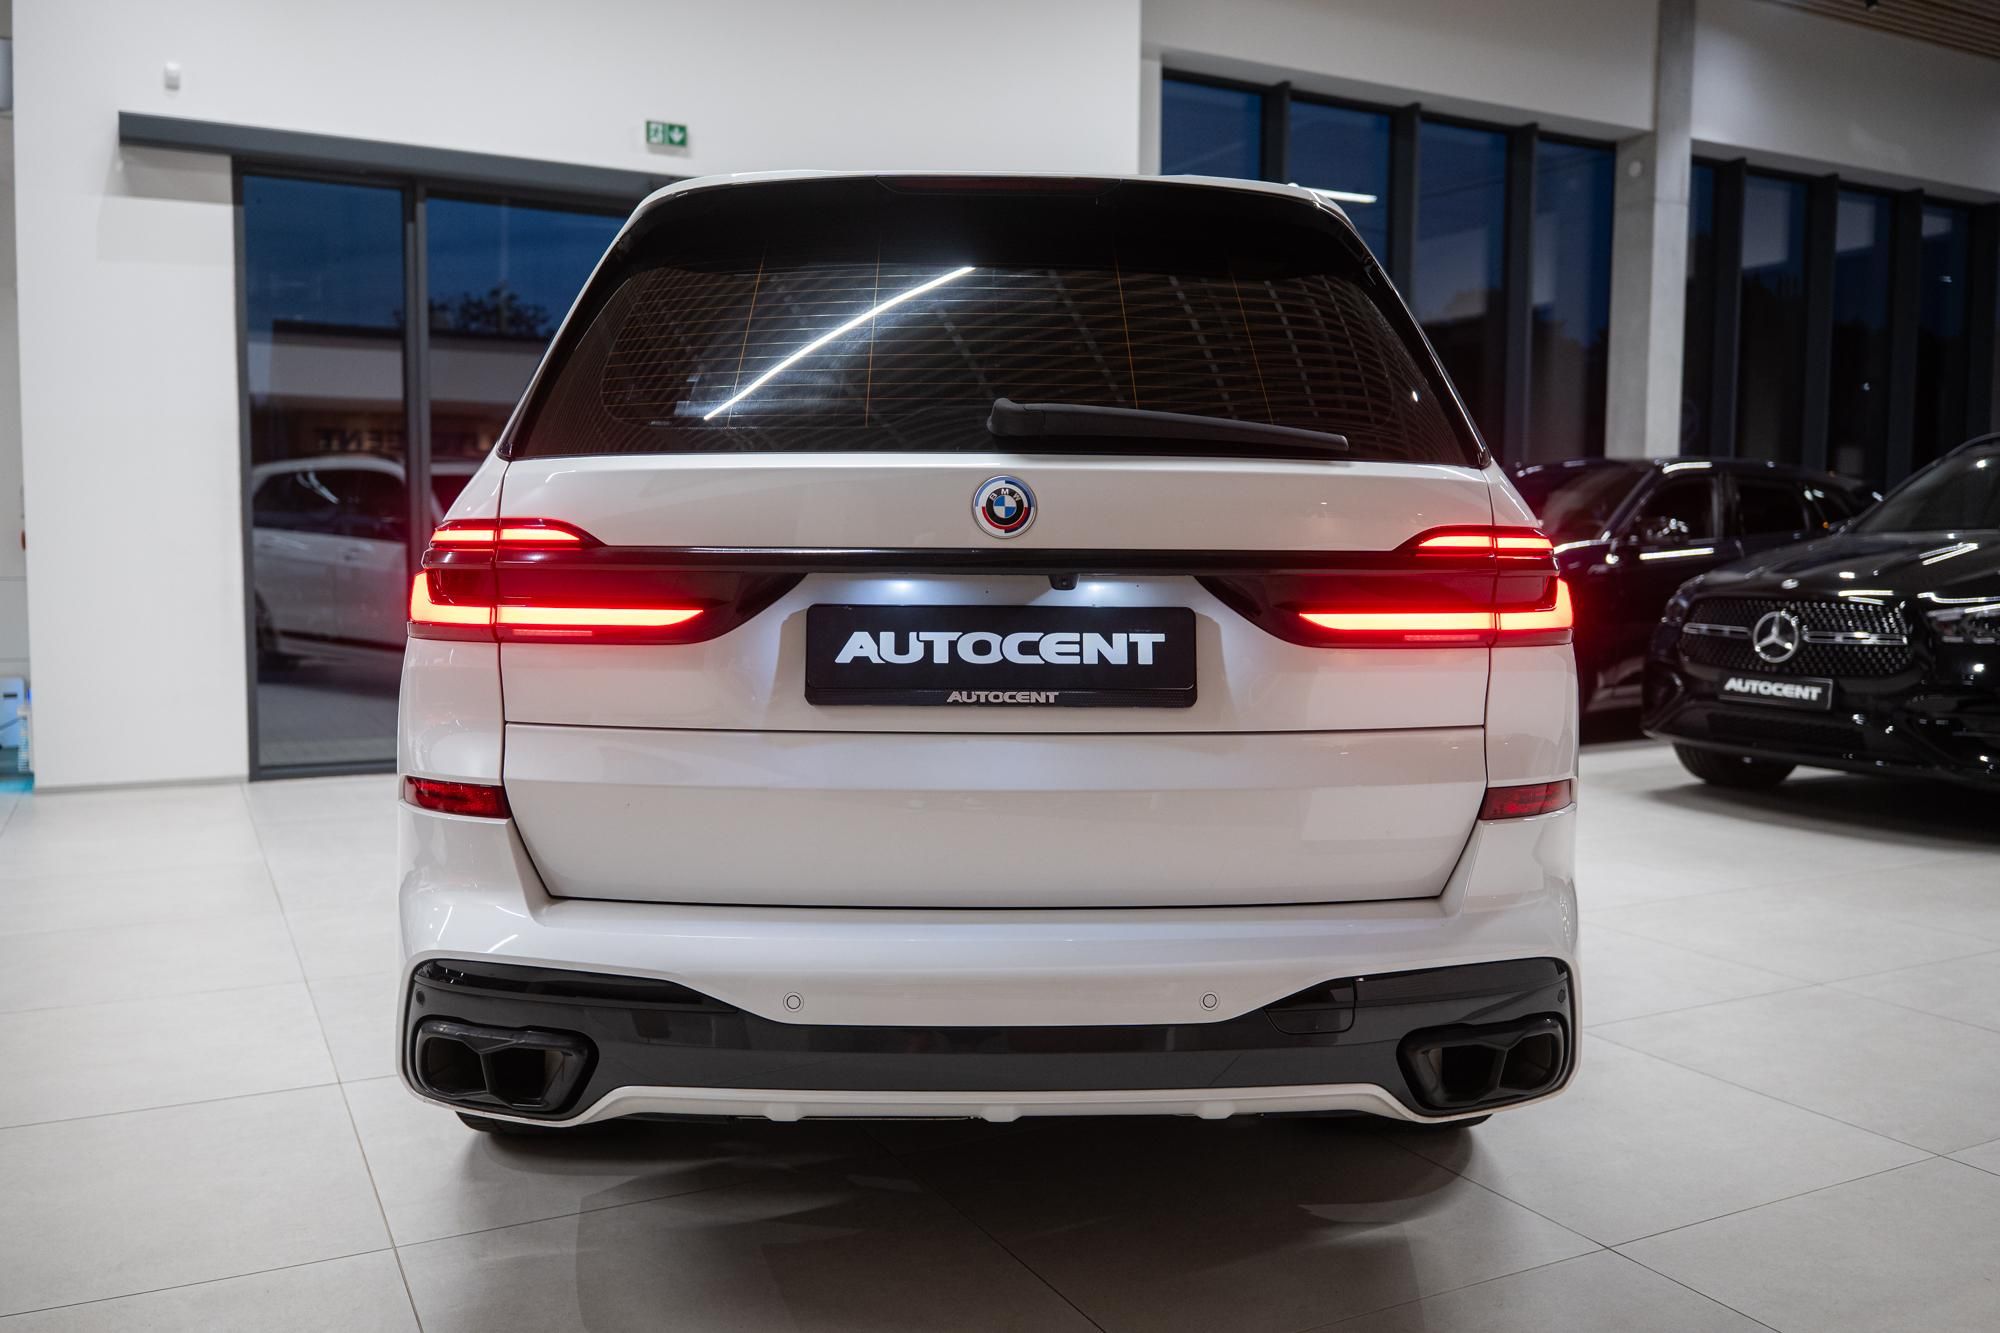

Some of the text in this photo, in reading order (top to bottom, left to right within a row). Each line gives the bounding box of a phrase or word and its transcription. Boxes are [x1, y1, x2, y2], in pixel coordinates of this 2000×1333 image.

[990, 488, 1021, 500] BMW
[834, 631, 1165, 665] AUTOCENT
[946, 690, 1059, 704] AUTOCENT
[1724, 677, 1822, 701] AUTOCENT
